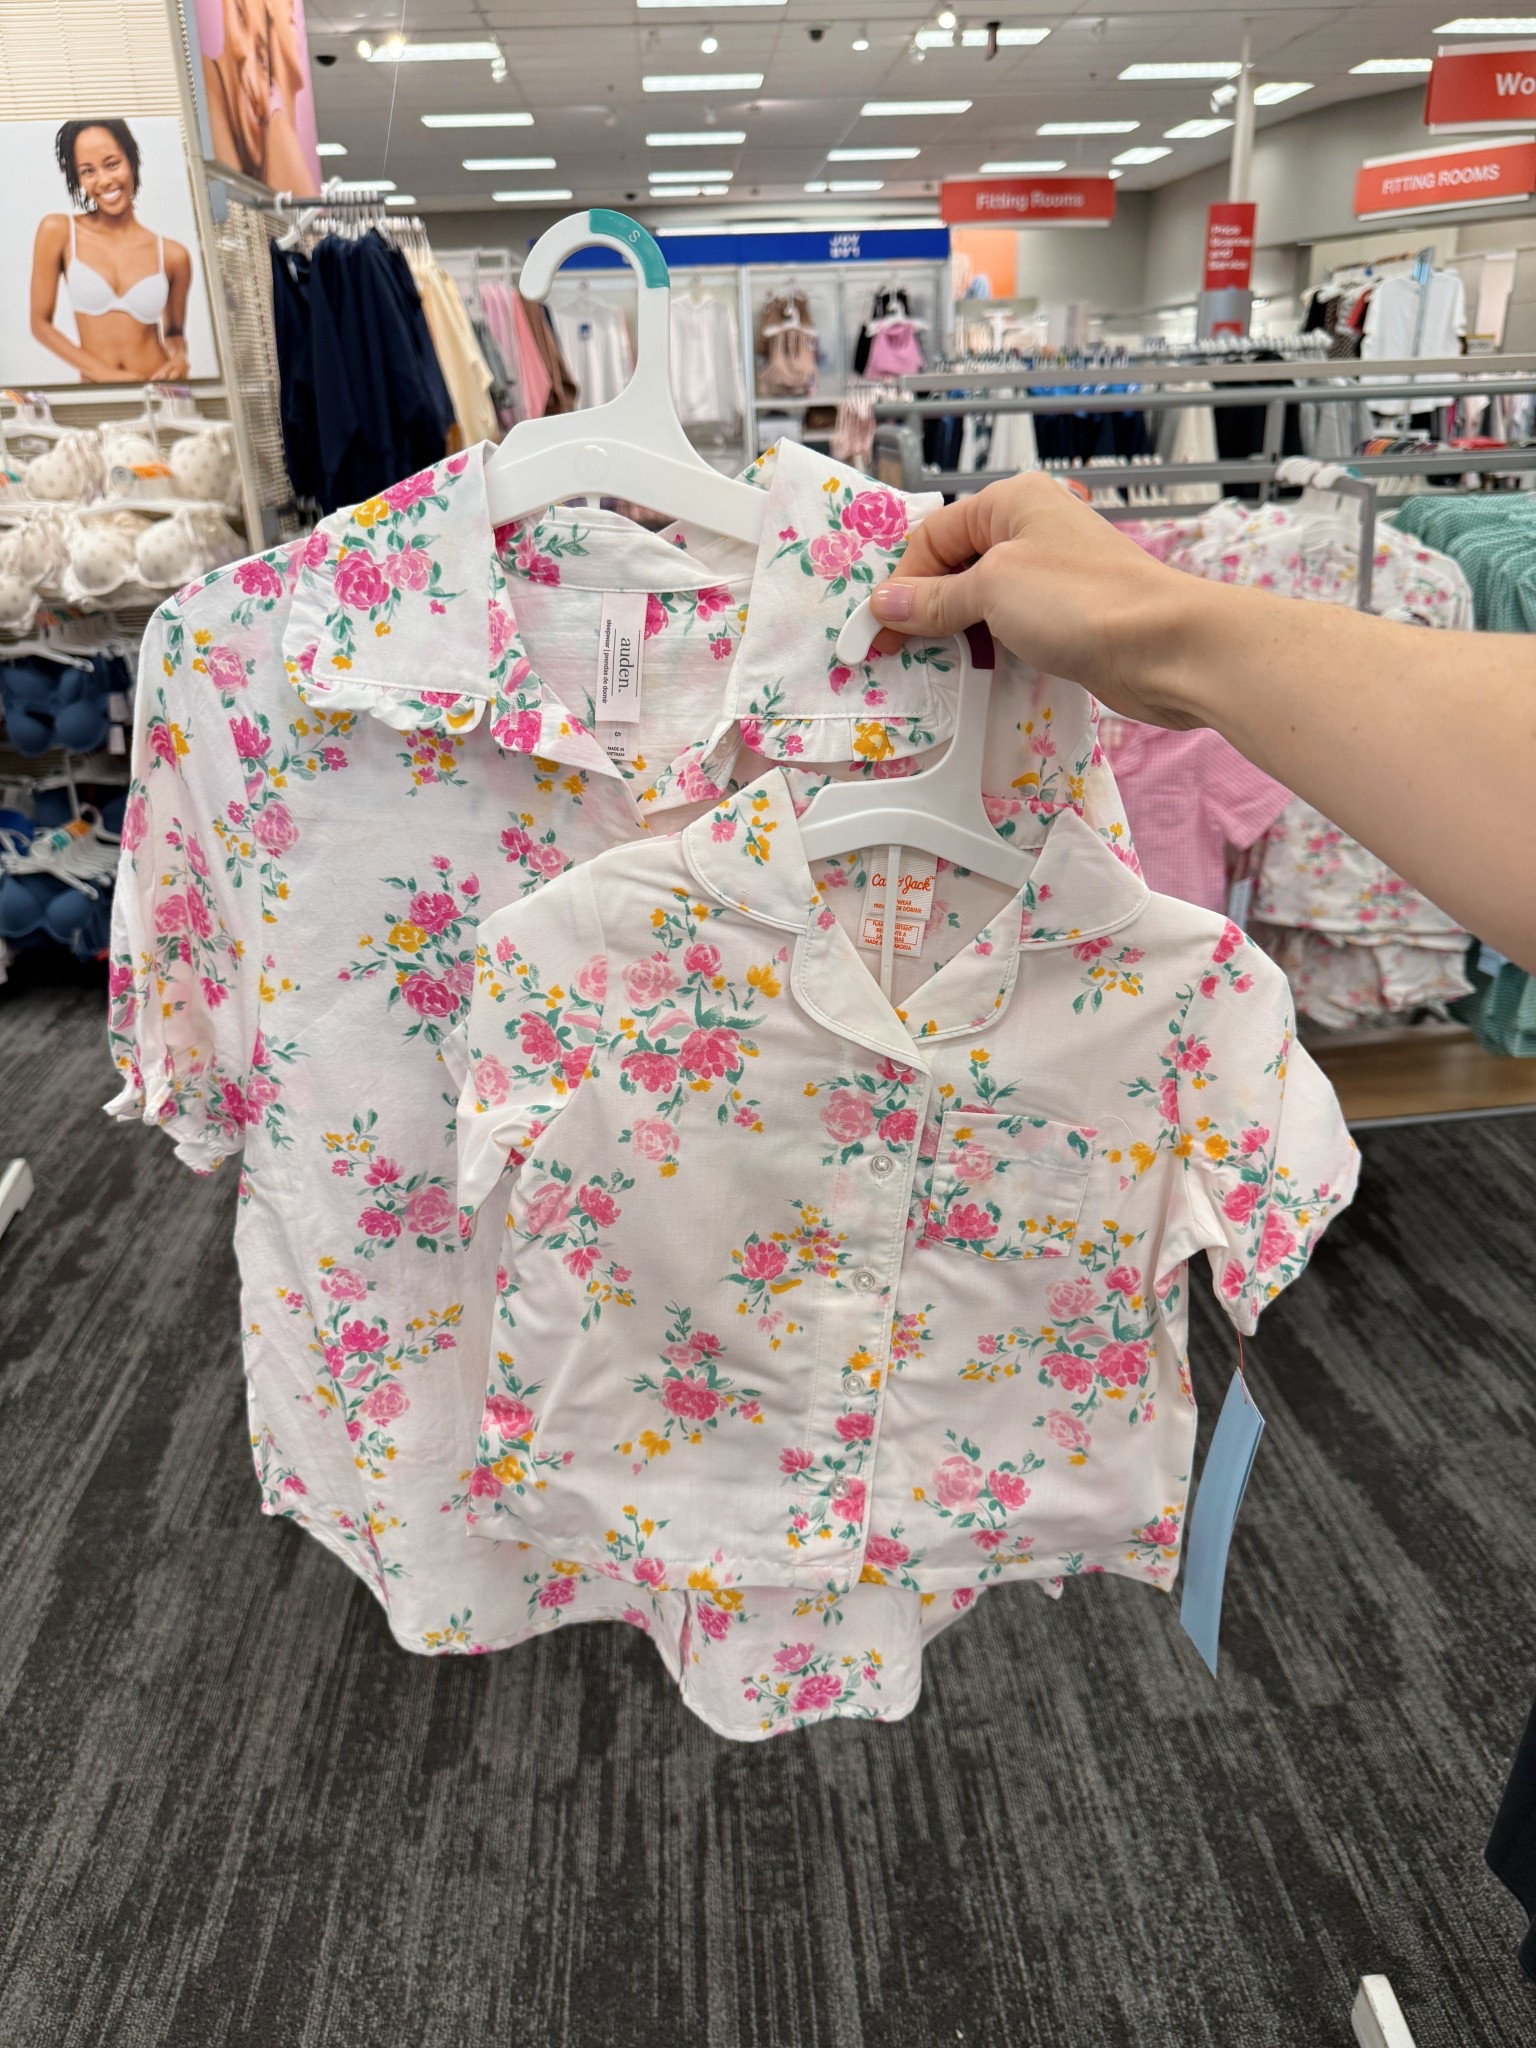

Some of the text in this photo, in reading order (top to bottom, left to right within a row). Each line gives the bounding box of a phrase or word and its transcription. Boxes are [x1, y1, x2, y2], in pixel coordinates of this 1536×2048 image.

[1382, 163, 1500, 196] FITTING ROOMS
[976, 190, 1085, 212] Fitting Rooms
[628, 229, 641, 243] S
